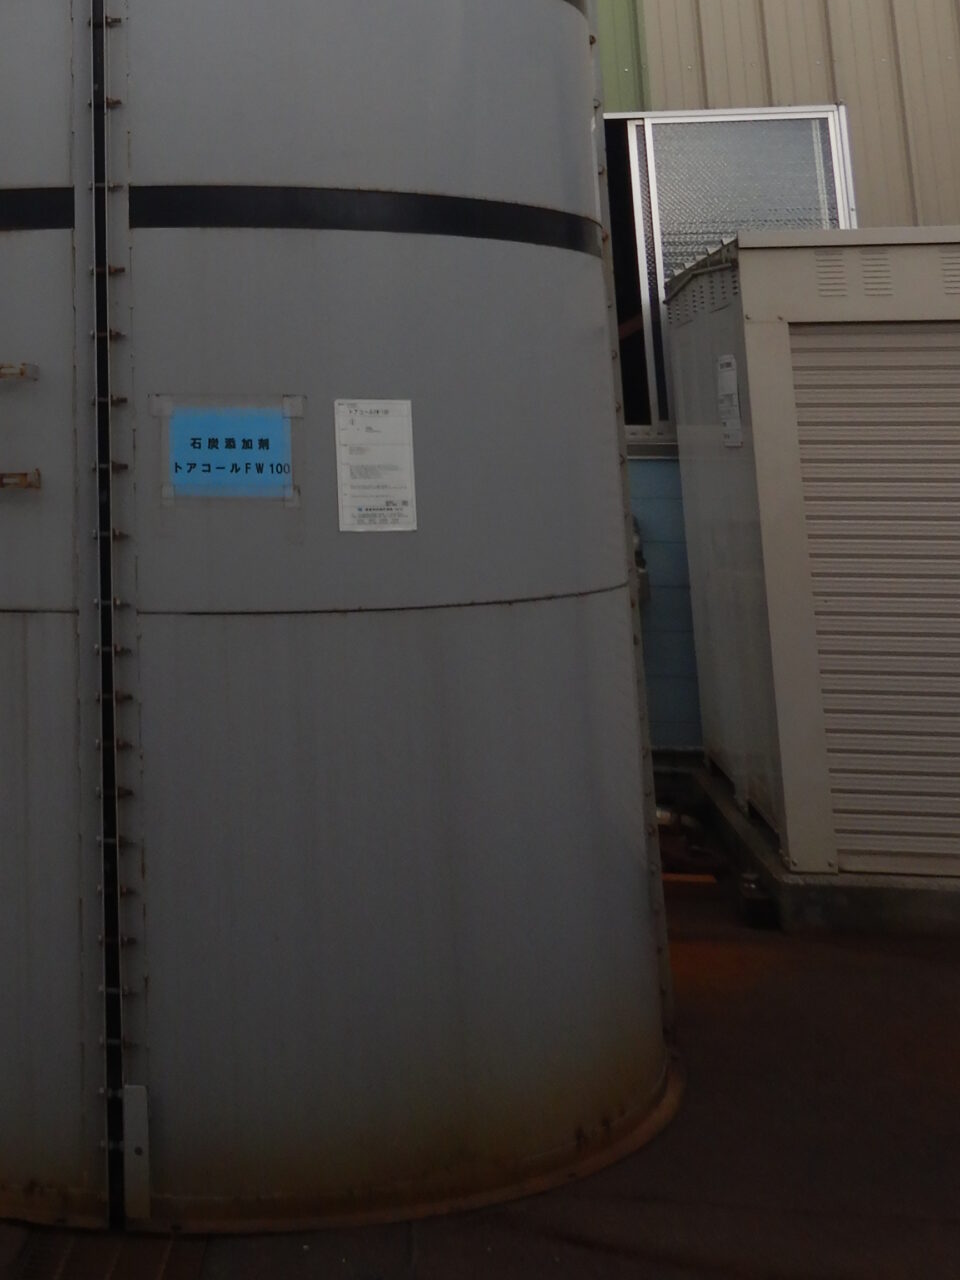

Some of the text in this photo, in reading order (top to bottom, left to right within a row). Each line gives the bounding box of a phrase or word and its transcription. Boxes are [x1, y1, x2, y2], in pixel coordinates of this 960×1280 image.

[190, 437, 270, 450] 石炭添加剤
